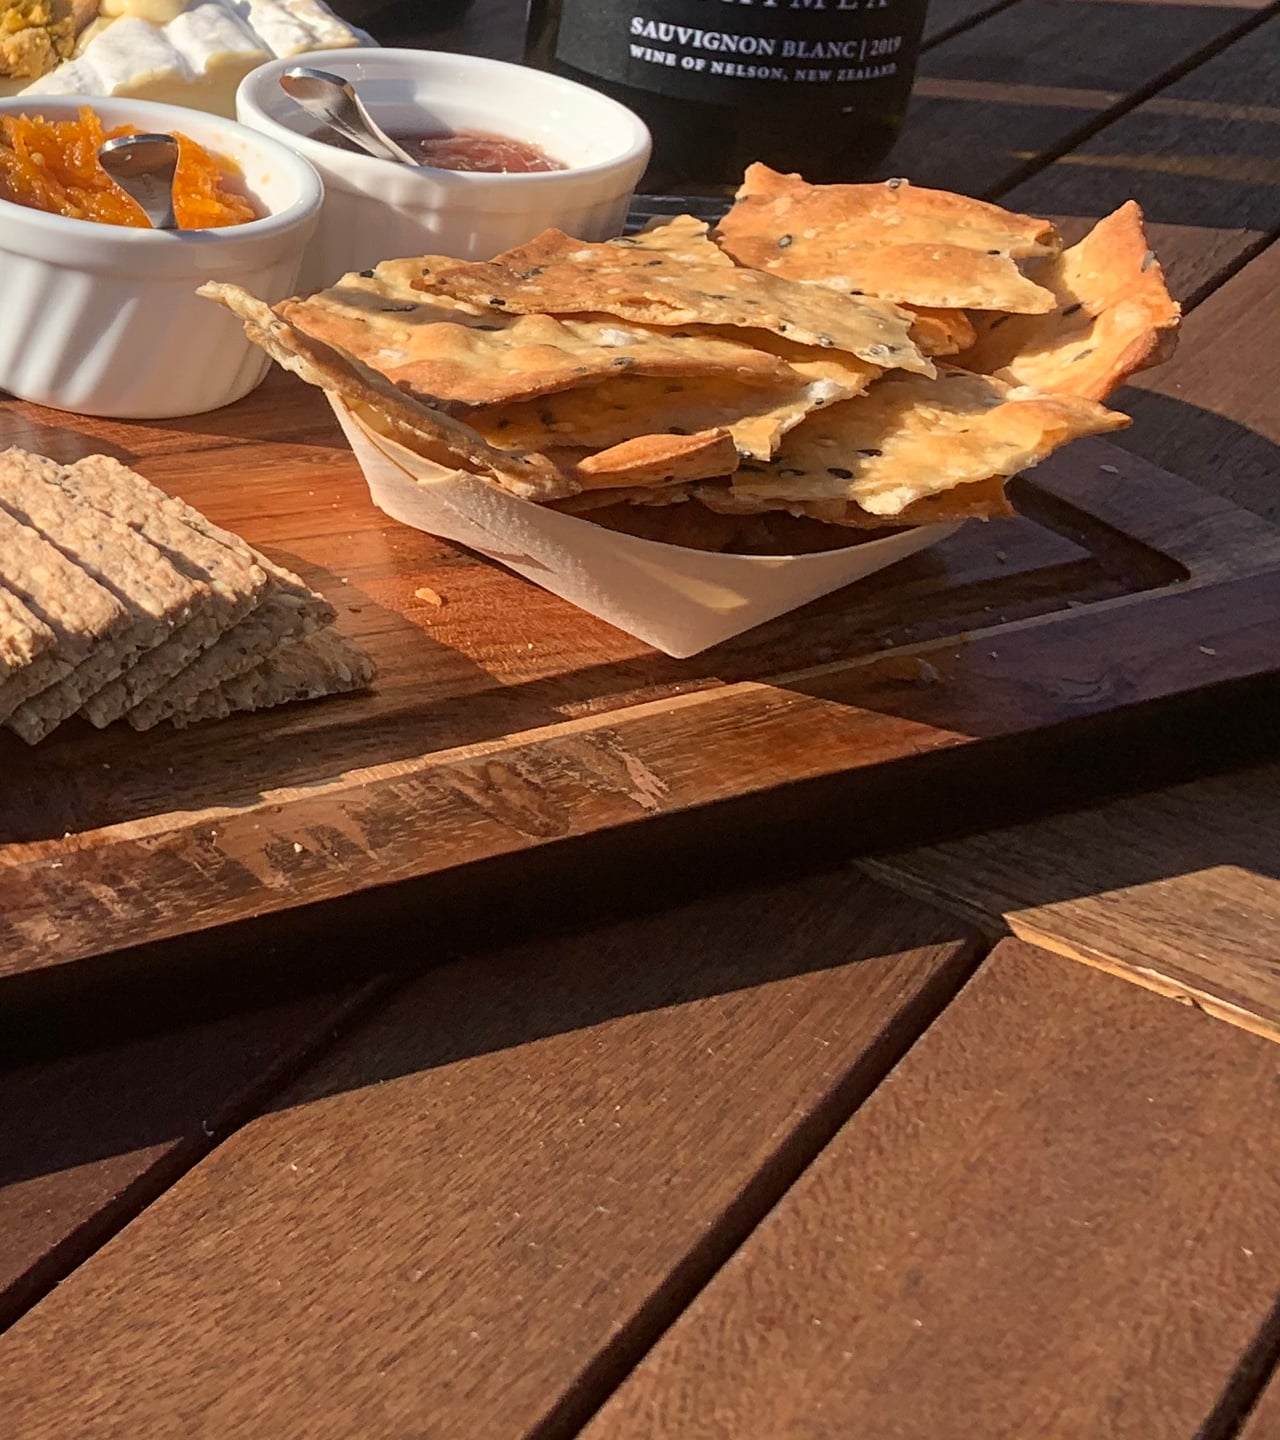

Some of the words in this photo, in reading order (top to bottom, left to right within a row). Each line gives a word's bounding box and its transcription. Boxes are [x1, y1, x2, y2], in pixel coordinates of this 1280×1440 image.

[630, 16, 776, 56] SAUVIGNON
[782, 40, 858, 58] BLANC
[870, 36, 902, 56] 2019
[630, 44, 676, 66] WINE
[681, 56, 706, 71] OF
[711, 61, 788, 82] NELSON,
[794, 70, 832, 82] NEW
[837, 63, 897, 81] ZEALAND
